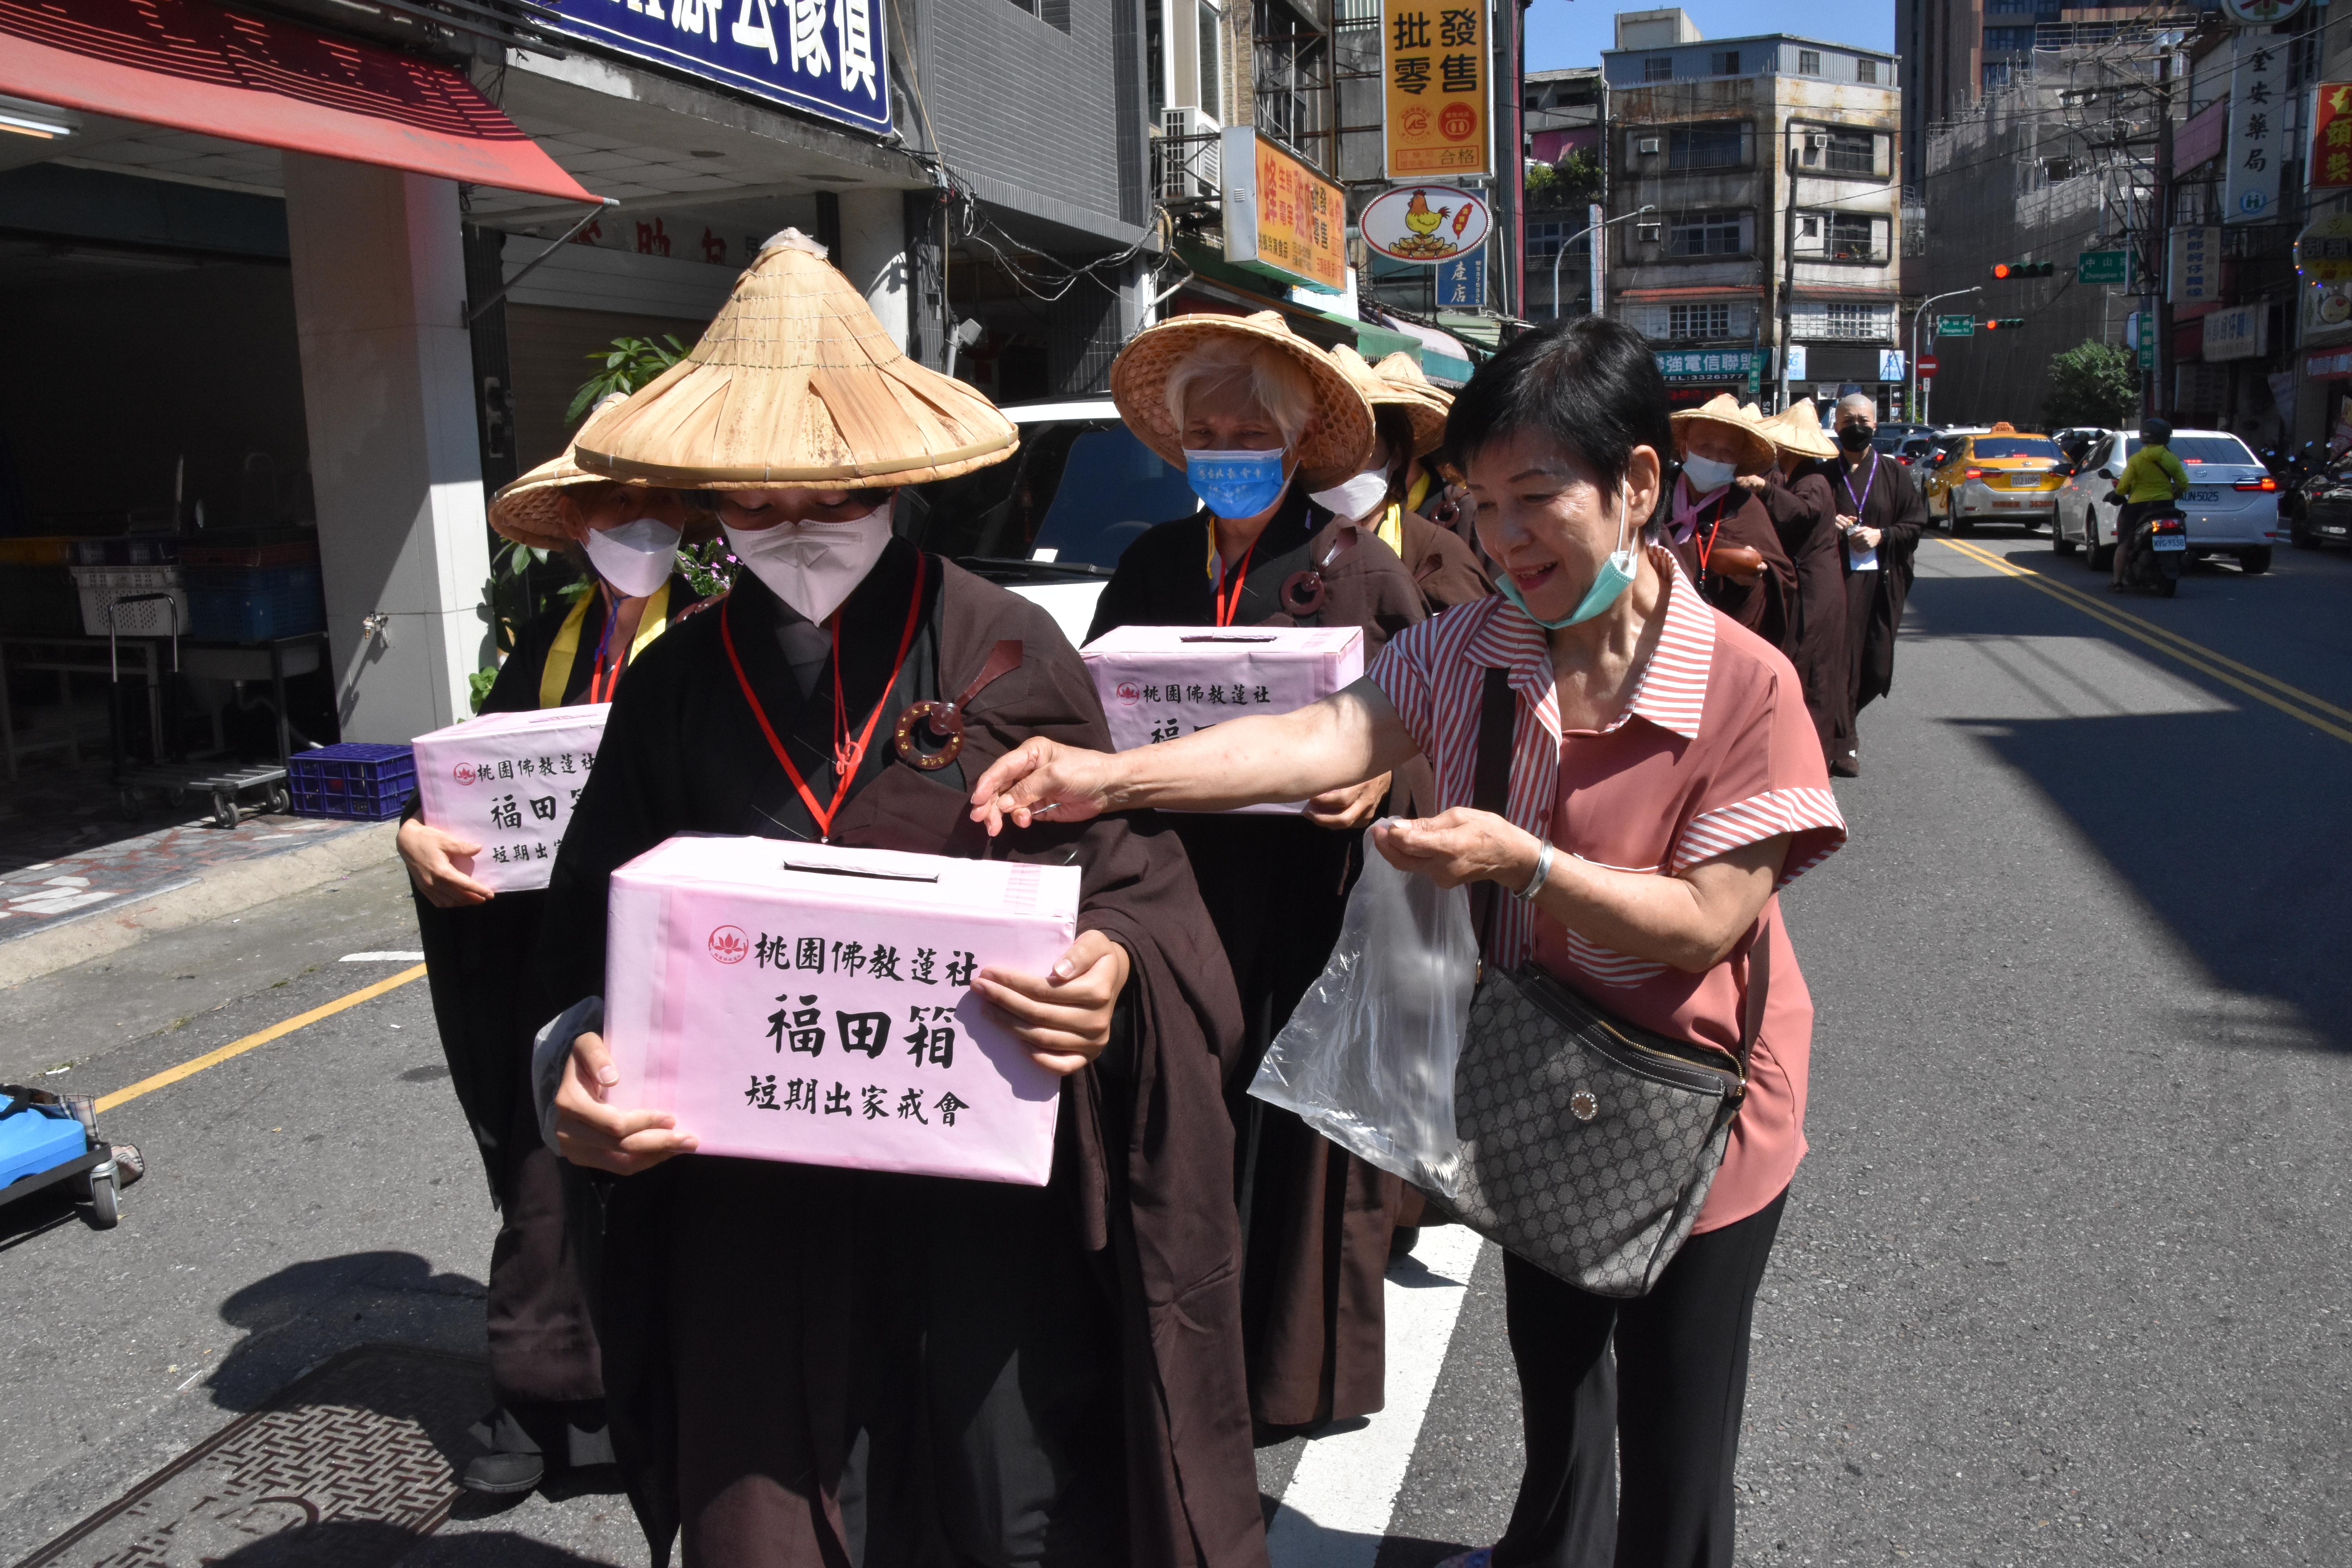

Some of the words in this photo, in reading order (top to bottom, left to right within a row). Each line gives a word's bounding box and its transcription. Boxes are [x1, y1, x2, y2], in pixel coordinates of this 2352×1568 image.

[626, 0, 876, 100] 公傢俱
[1393, 9, 1477, 51] 批發
[1394, 54, 1477, 94] 零售
[1441, 149, 1474, 165] 合格
[1450, 261, 1467, 303] 產店
[1143, 683, 1271, 705] 桃園佛教蓮社
[477, 753, 596, 782] 桃園佛教蓮社
[753, 933, 978, 987] 桃園佛教蓮社
[765, 994, 958, 1069] 福田箱
[744, 1075, 970, 1127] 短期出家戒會
